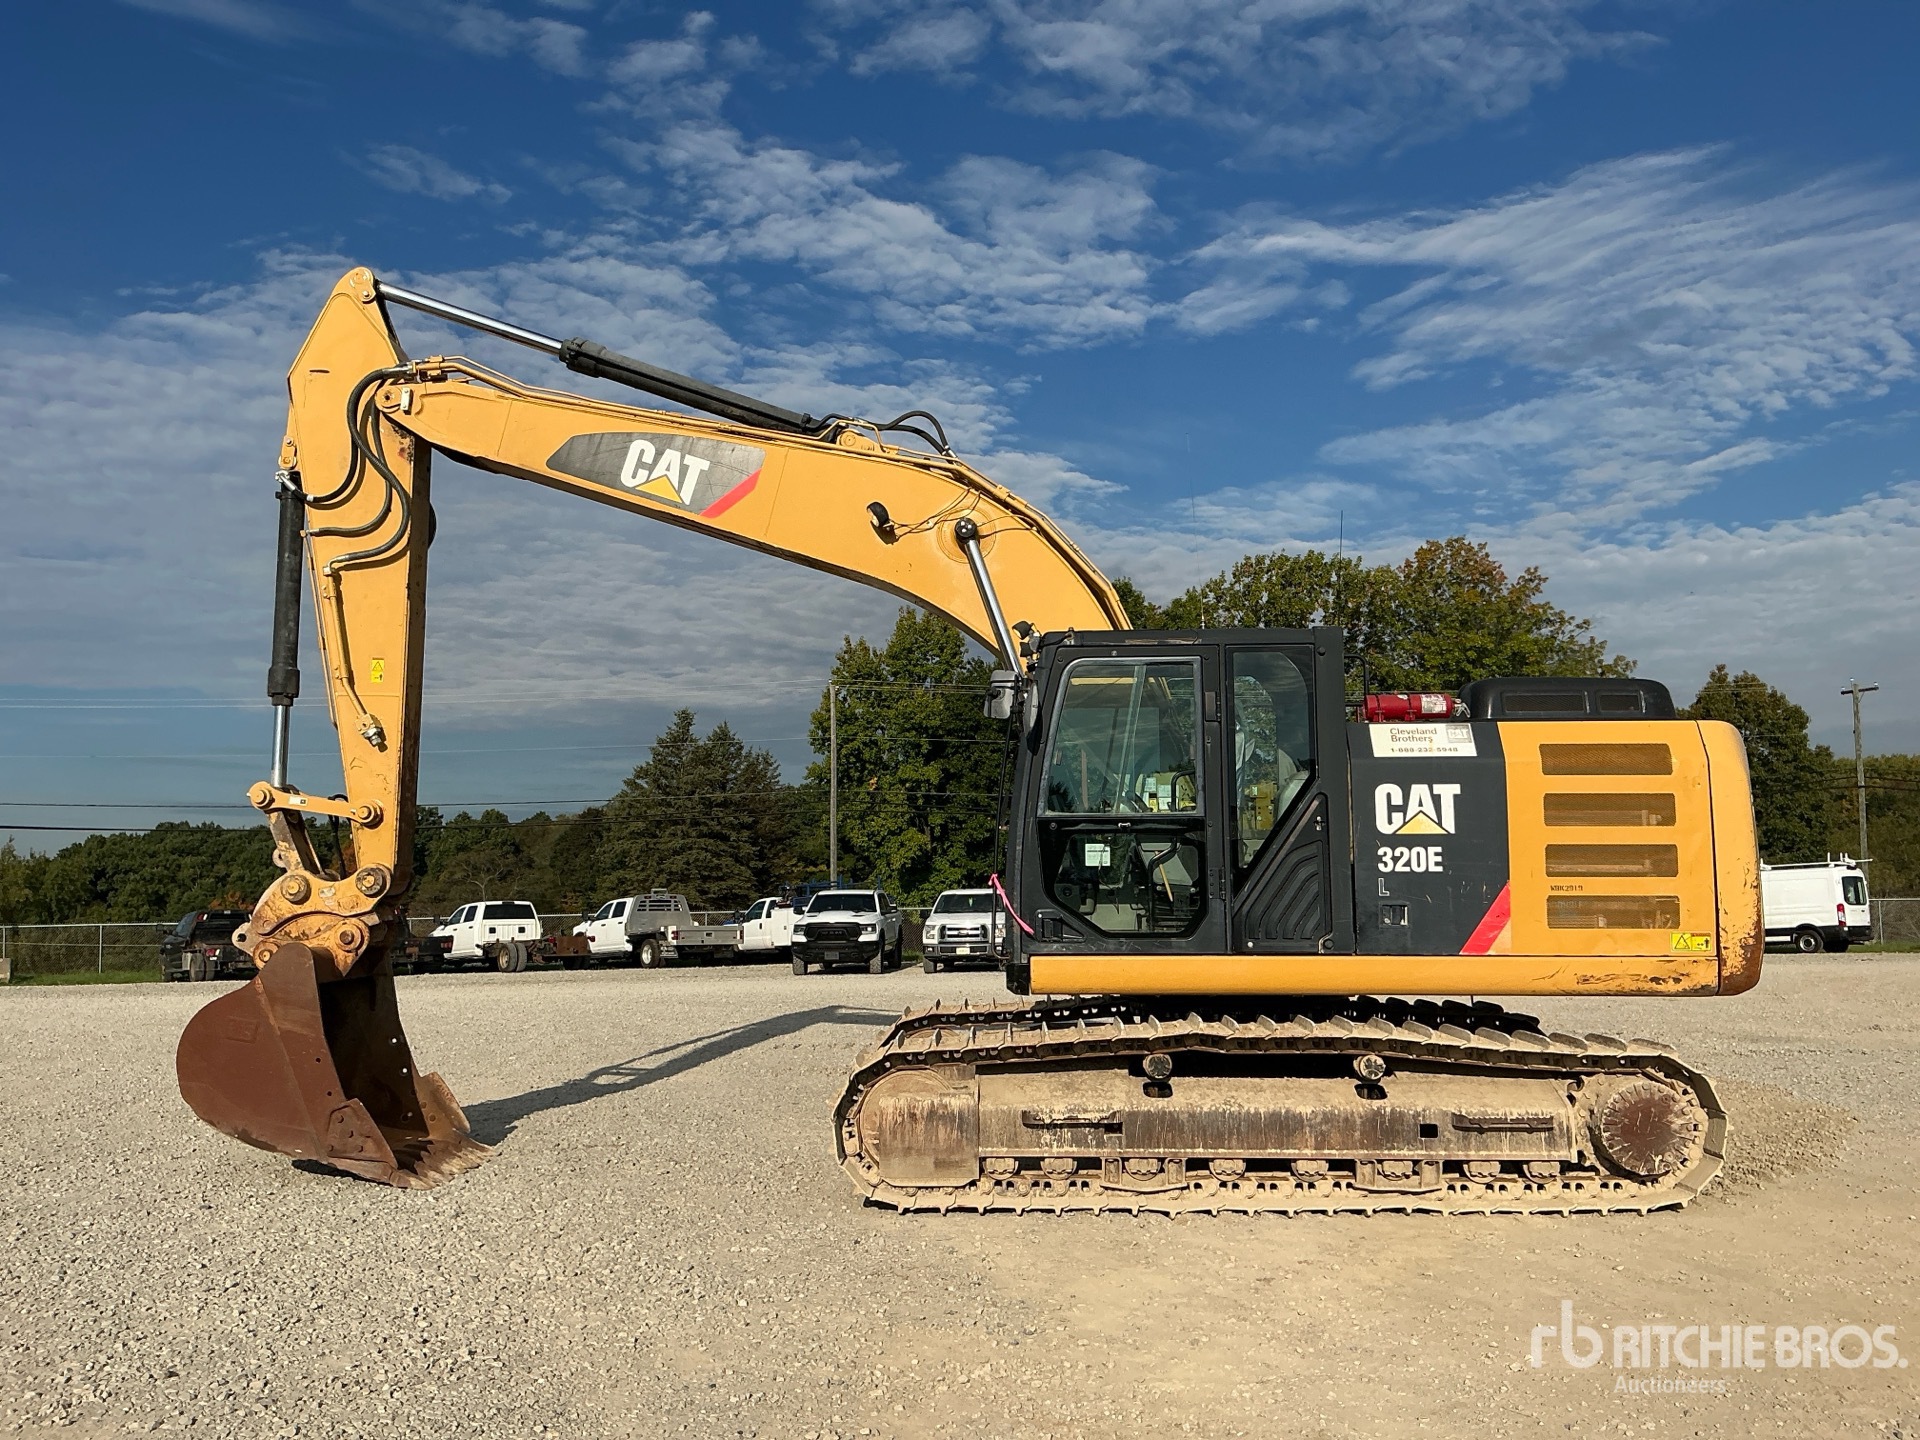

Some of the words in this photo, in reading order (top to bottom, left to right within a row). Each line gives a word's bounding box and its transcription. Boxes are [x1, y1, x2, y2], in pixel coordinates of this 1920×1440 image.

[620, 439, 710, 506] CAT
[1389, 727, 1438, 735] Cleveland
[1390, 735, 1433, 743] Brothers
[1375, 783, 1461, 835] CAT
[1377, 846, 1444, 873] 320E
[1378, 877, 1390, 896] L
